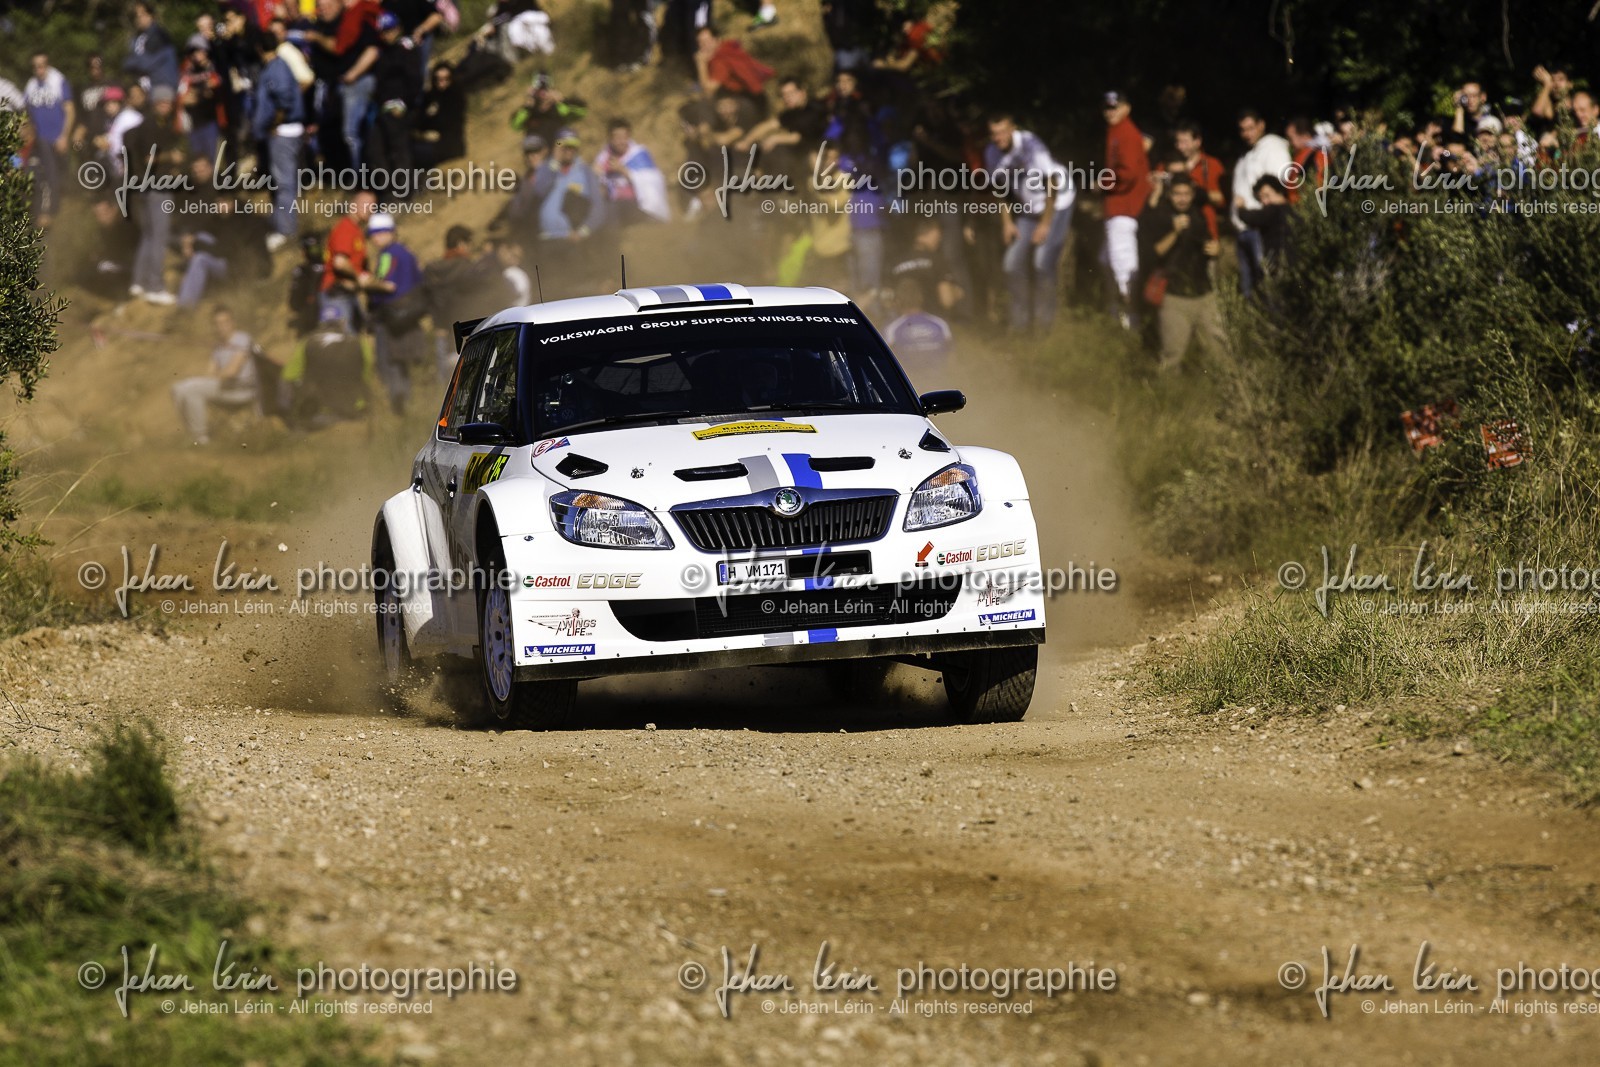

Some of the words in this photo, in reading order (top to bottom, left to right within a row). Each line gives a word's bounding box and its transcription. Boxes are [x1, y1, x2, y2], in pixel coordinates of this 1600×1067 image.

[540, 325, 634, 345] VOLKSWAGEN
[641, 320, 688, 329] GROUP
[691, 316, 756, 325] SUPPORTS
[833, 317, 858, 325] LIFE
[945, 549, 972, 564] Castrol
[976, 538, 1027, 562] EDGE
[728, 564, 737, 578] H
[535, 575, 571, 587] Castrol
[576, 572, 644, 589] EDGE
[992, 610, 1033, 622] MICHELIN
[542, 645, 592, 654] MICHELIN
